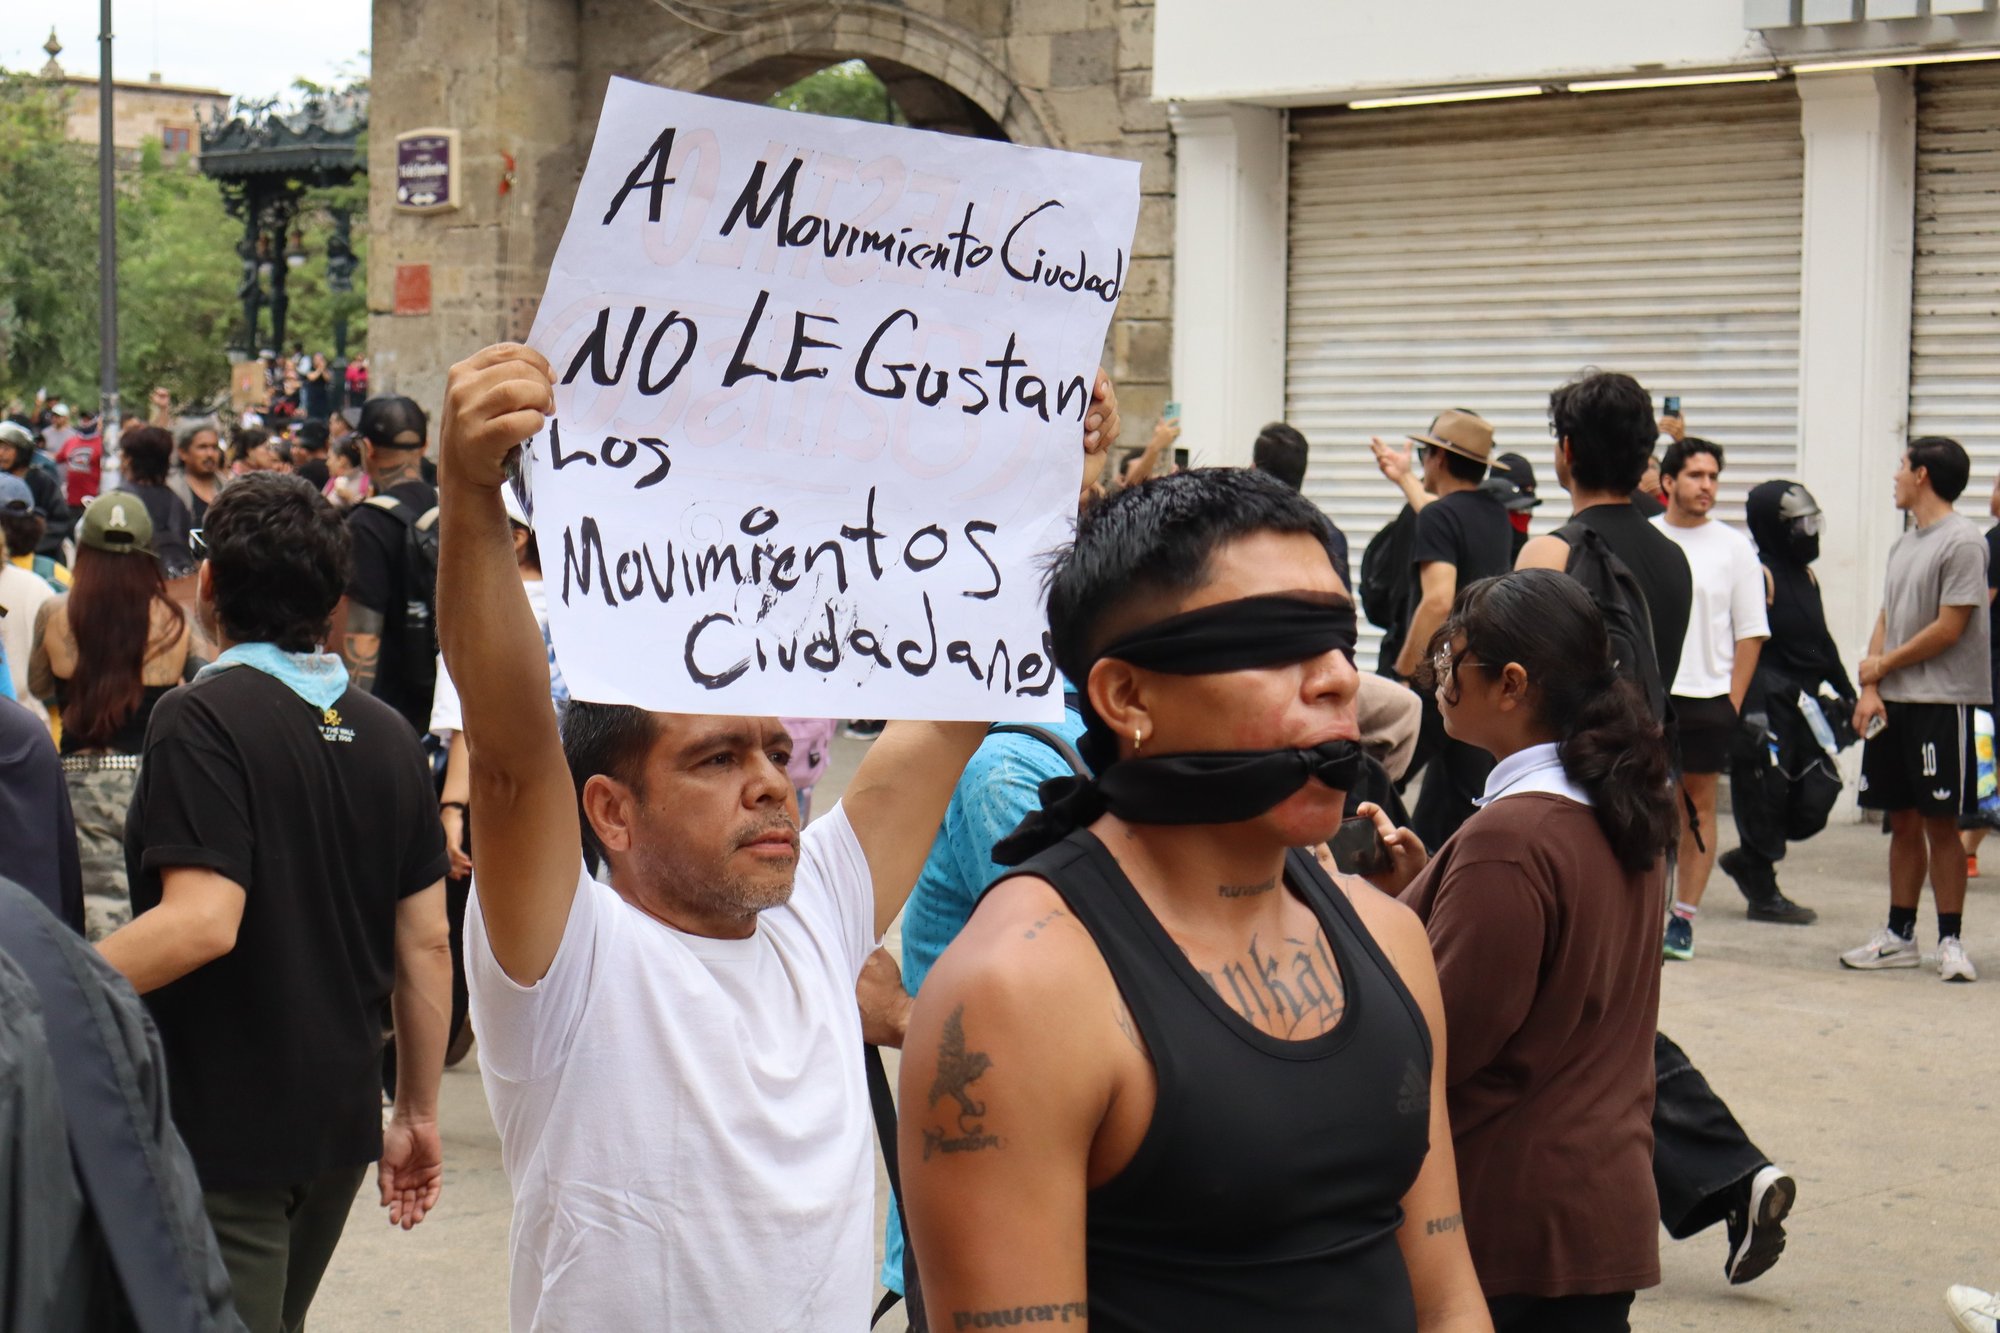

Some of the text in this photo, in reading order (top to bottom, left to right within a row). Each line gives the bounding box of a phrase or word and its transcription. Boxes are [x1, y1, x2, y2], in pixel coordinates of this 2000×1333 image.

[602, 126, 677, 226] A
[719, 157, 993, 278] Movimiento
[561, 289, 1088, 423] NO LE Gustan
[561, 486, 1002, 608] Movimientos
[684, 590, 1057, 698] Ciudadanos
[1921, 742, 1937, 776] 10
